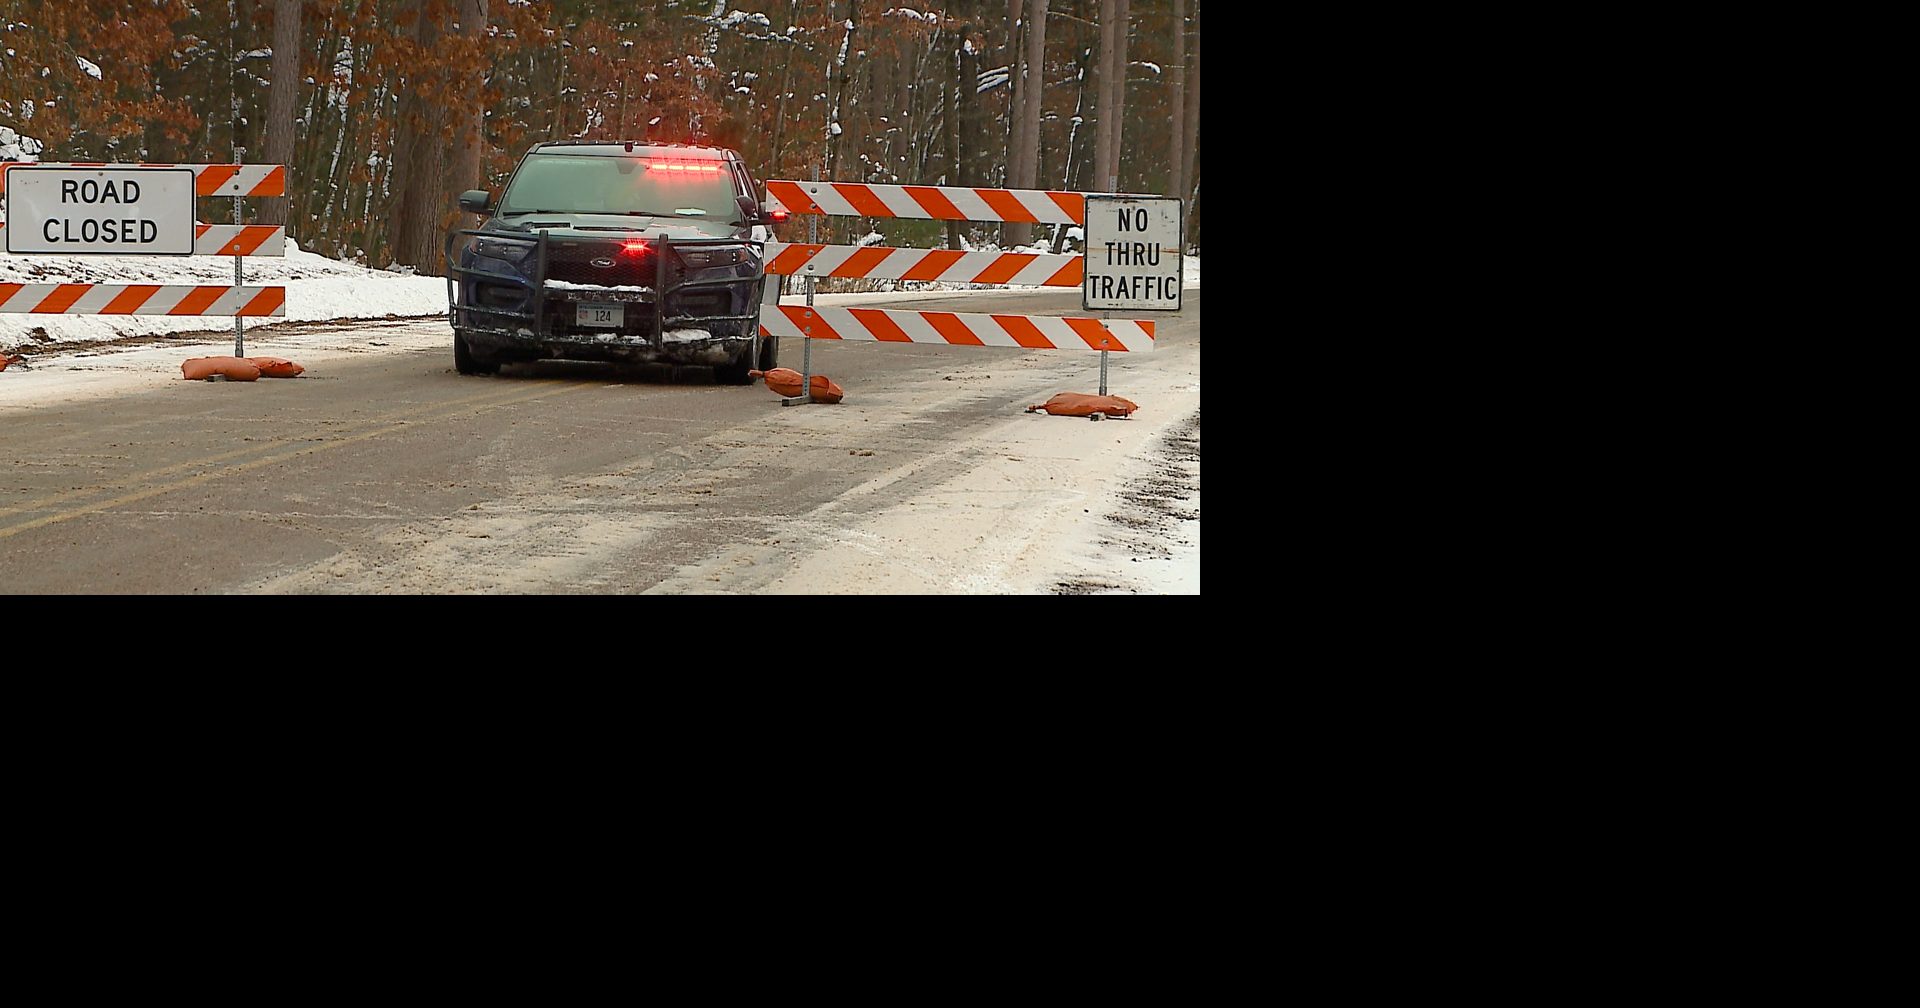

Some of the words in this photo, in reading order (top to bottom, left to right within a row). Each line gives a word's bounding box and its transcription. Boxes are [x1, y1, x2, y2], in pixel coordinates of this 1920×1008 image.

[61, 179, 140, 204] ROAD
[43, 218, 158, 244] CLOSED
[1118, 208, 1148, 232] NO
[1105, 242, 1160, 266] THRU
[1089, 275, 1177, 300] TRAFFIC
[595, 311, 611, 322] 124
